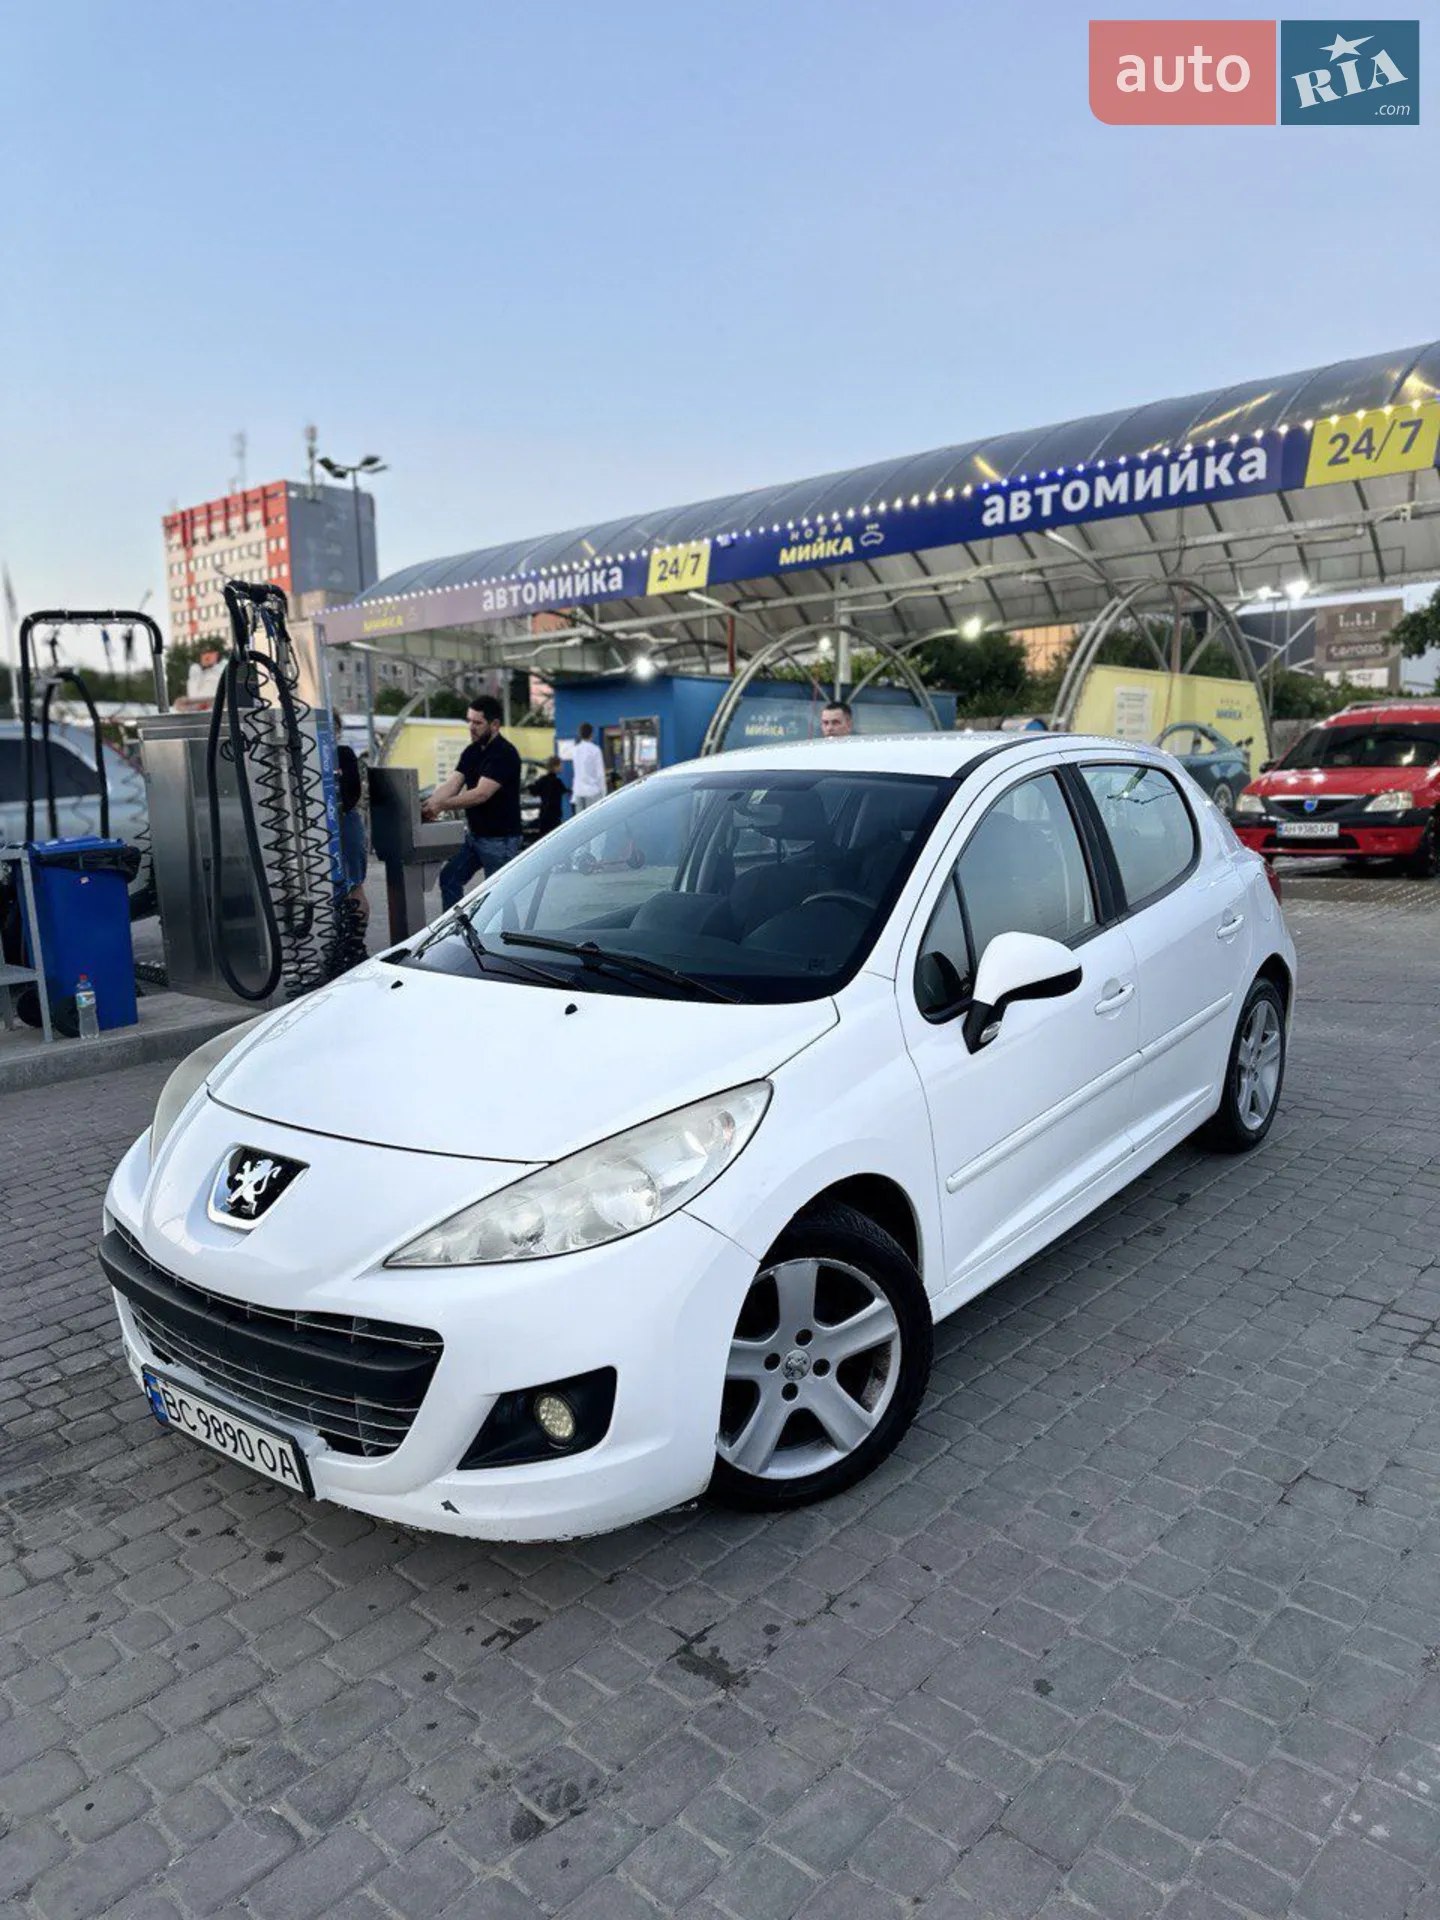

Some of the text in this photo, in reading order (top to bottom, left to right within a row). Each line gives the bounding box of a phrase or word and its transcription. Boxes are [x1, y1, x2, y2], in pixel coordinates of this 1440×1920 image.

[981, 418, 1425, 527] автомийка 24/7
[778, 536, 854, 566] МИЙКА
[790, 522, 843, 541] НОВА
[482, 553, 701, 612] автомийка 24/7
[197, 1408, 255, 1462] 9890
